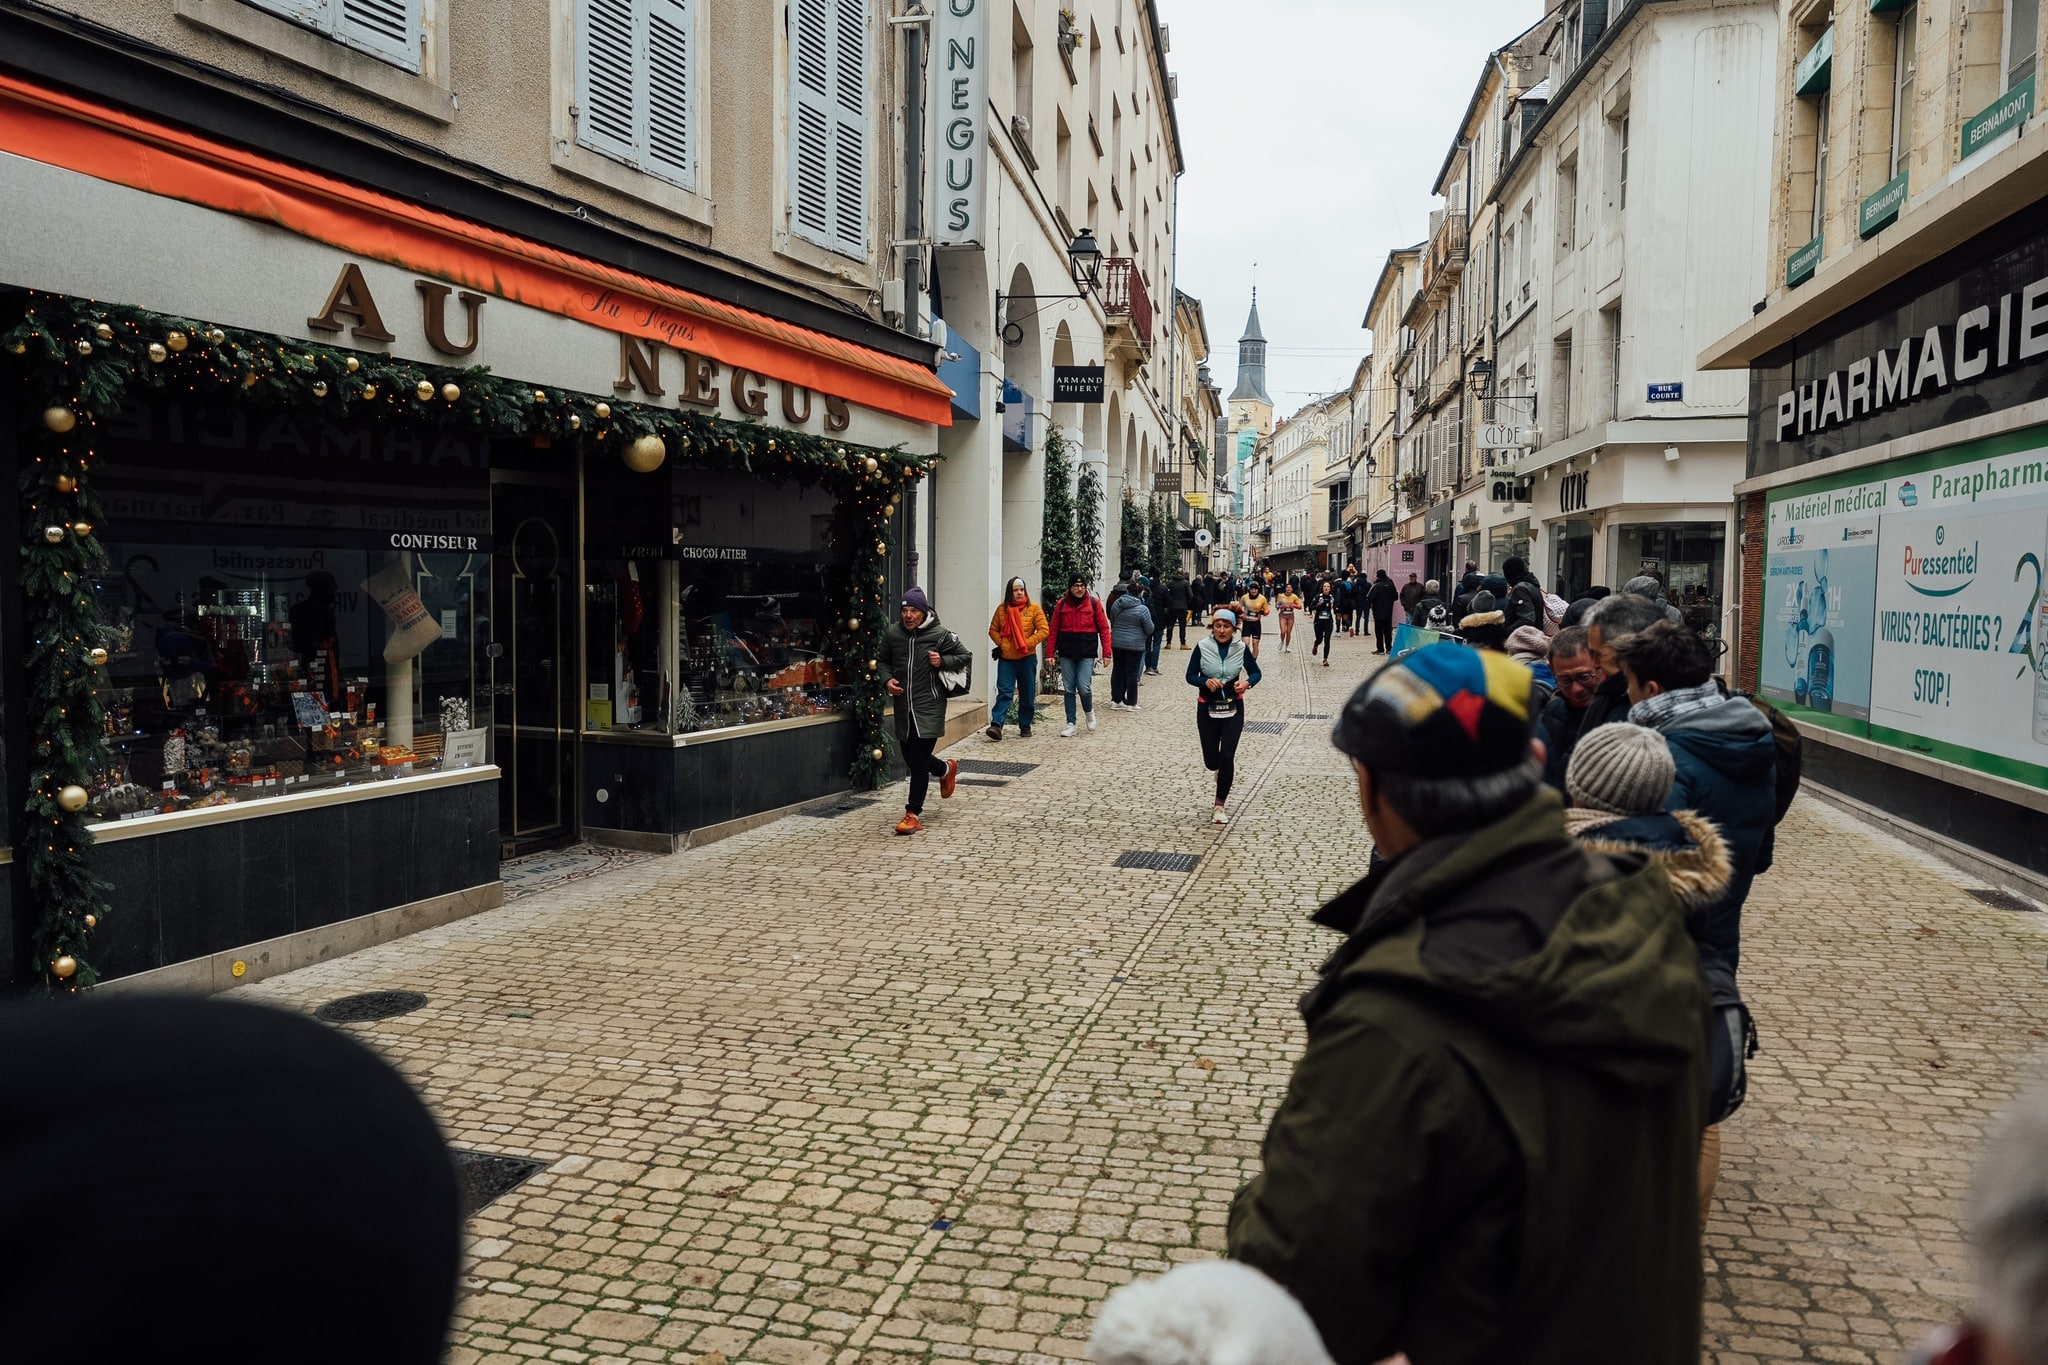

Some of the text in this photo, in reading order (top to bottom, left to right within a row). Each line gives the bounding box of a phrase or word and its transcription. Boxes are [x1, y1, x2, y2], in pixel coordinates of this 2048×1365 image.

[946, 36, 975, 231] NEGUS
[1969, 91, 2028, 145] BERNAMONT
[1865, 182, 1905, 221] BERNAMONT
[1790, 244, 1820, 275] BERNAMONT
[580, 289, 623, 320] Au
[307, 262, 851, 432] AU NEGUS
[1776, 276, 2048, 444] PHARMACIE
[1056, 376, 1103, 384] ARMAND
[1059, 384, 1099, 392] THIERY
[1649, 392, 1680, 400] COURTE
[1485, 425, 1520, 445] CLYDE
[1493, 481, 1526, 501] Riu
[1560, 470, 1589, 513] CLYDE
[1785, 483, 1887, 522] Matériel médical
[390, 533, 478, 551] CONFISEUR
[682, 547, 748, 560] CHOCOLATIER
[1903, 540, 1979, 576] Puressentiel
[1880, 610, 1912, 642] VIRUS
[1914, 613, 1921, 644] ?
[1922, 605, 1991, 651] BACTÉRIES
[1994, 615, 2003, 652] ?
[1914, 669, 1951, 707] STOP !
